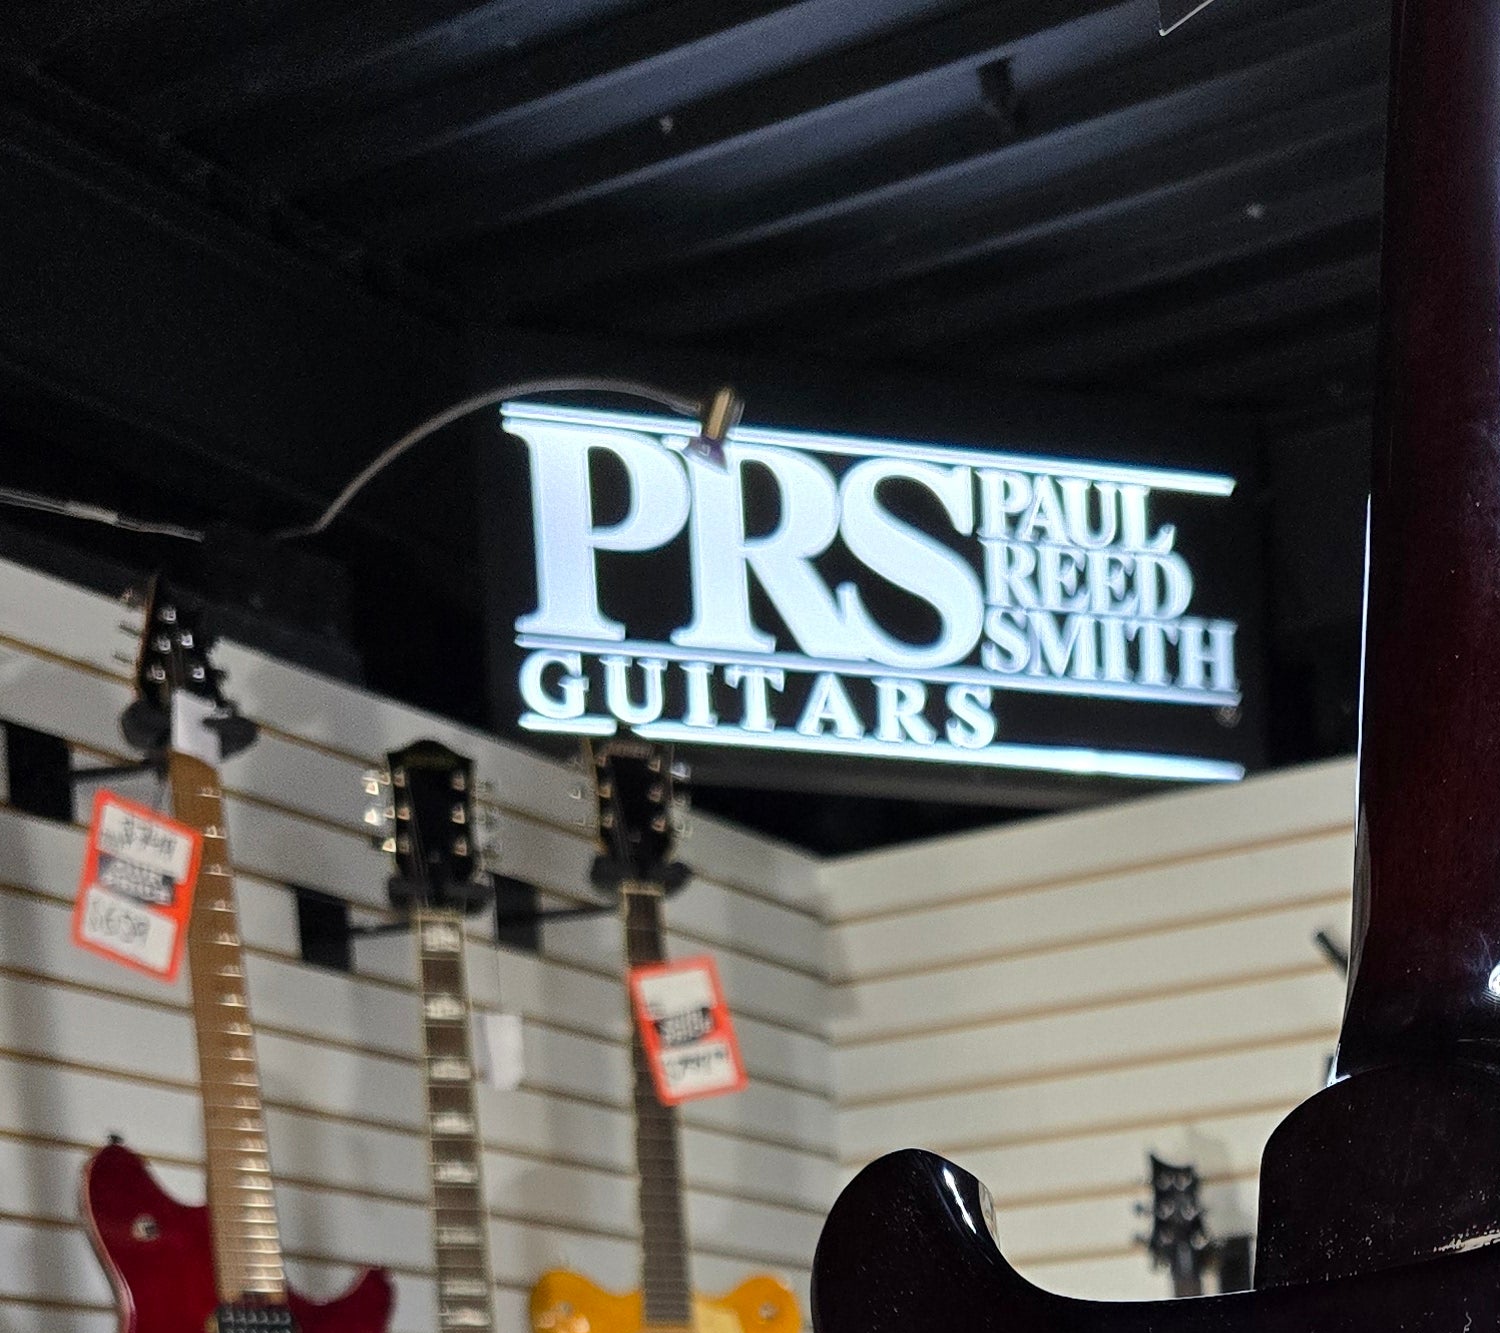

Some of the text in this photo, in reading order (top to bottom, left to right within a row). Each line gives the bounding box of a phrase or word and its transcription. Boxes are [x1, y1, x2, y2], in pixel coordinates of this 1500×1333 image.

[502, 419, 984, 669] PRS
[974, 468, 1175, 554] PAUL
[979, 538, 1193, 621] REED
[981, 606, 1239, 692] SMITH
[518, 650, 997, 748] GUITARS
